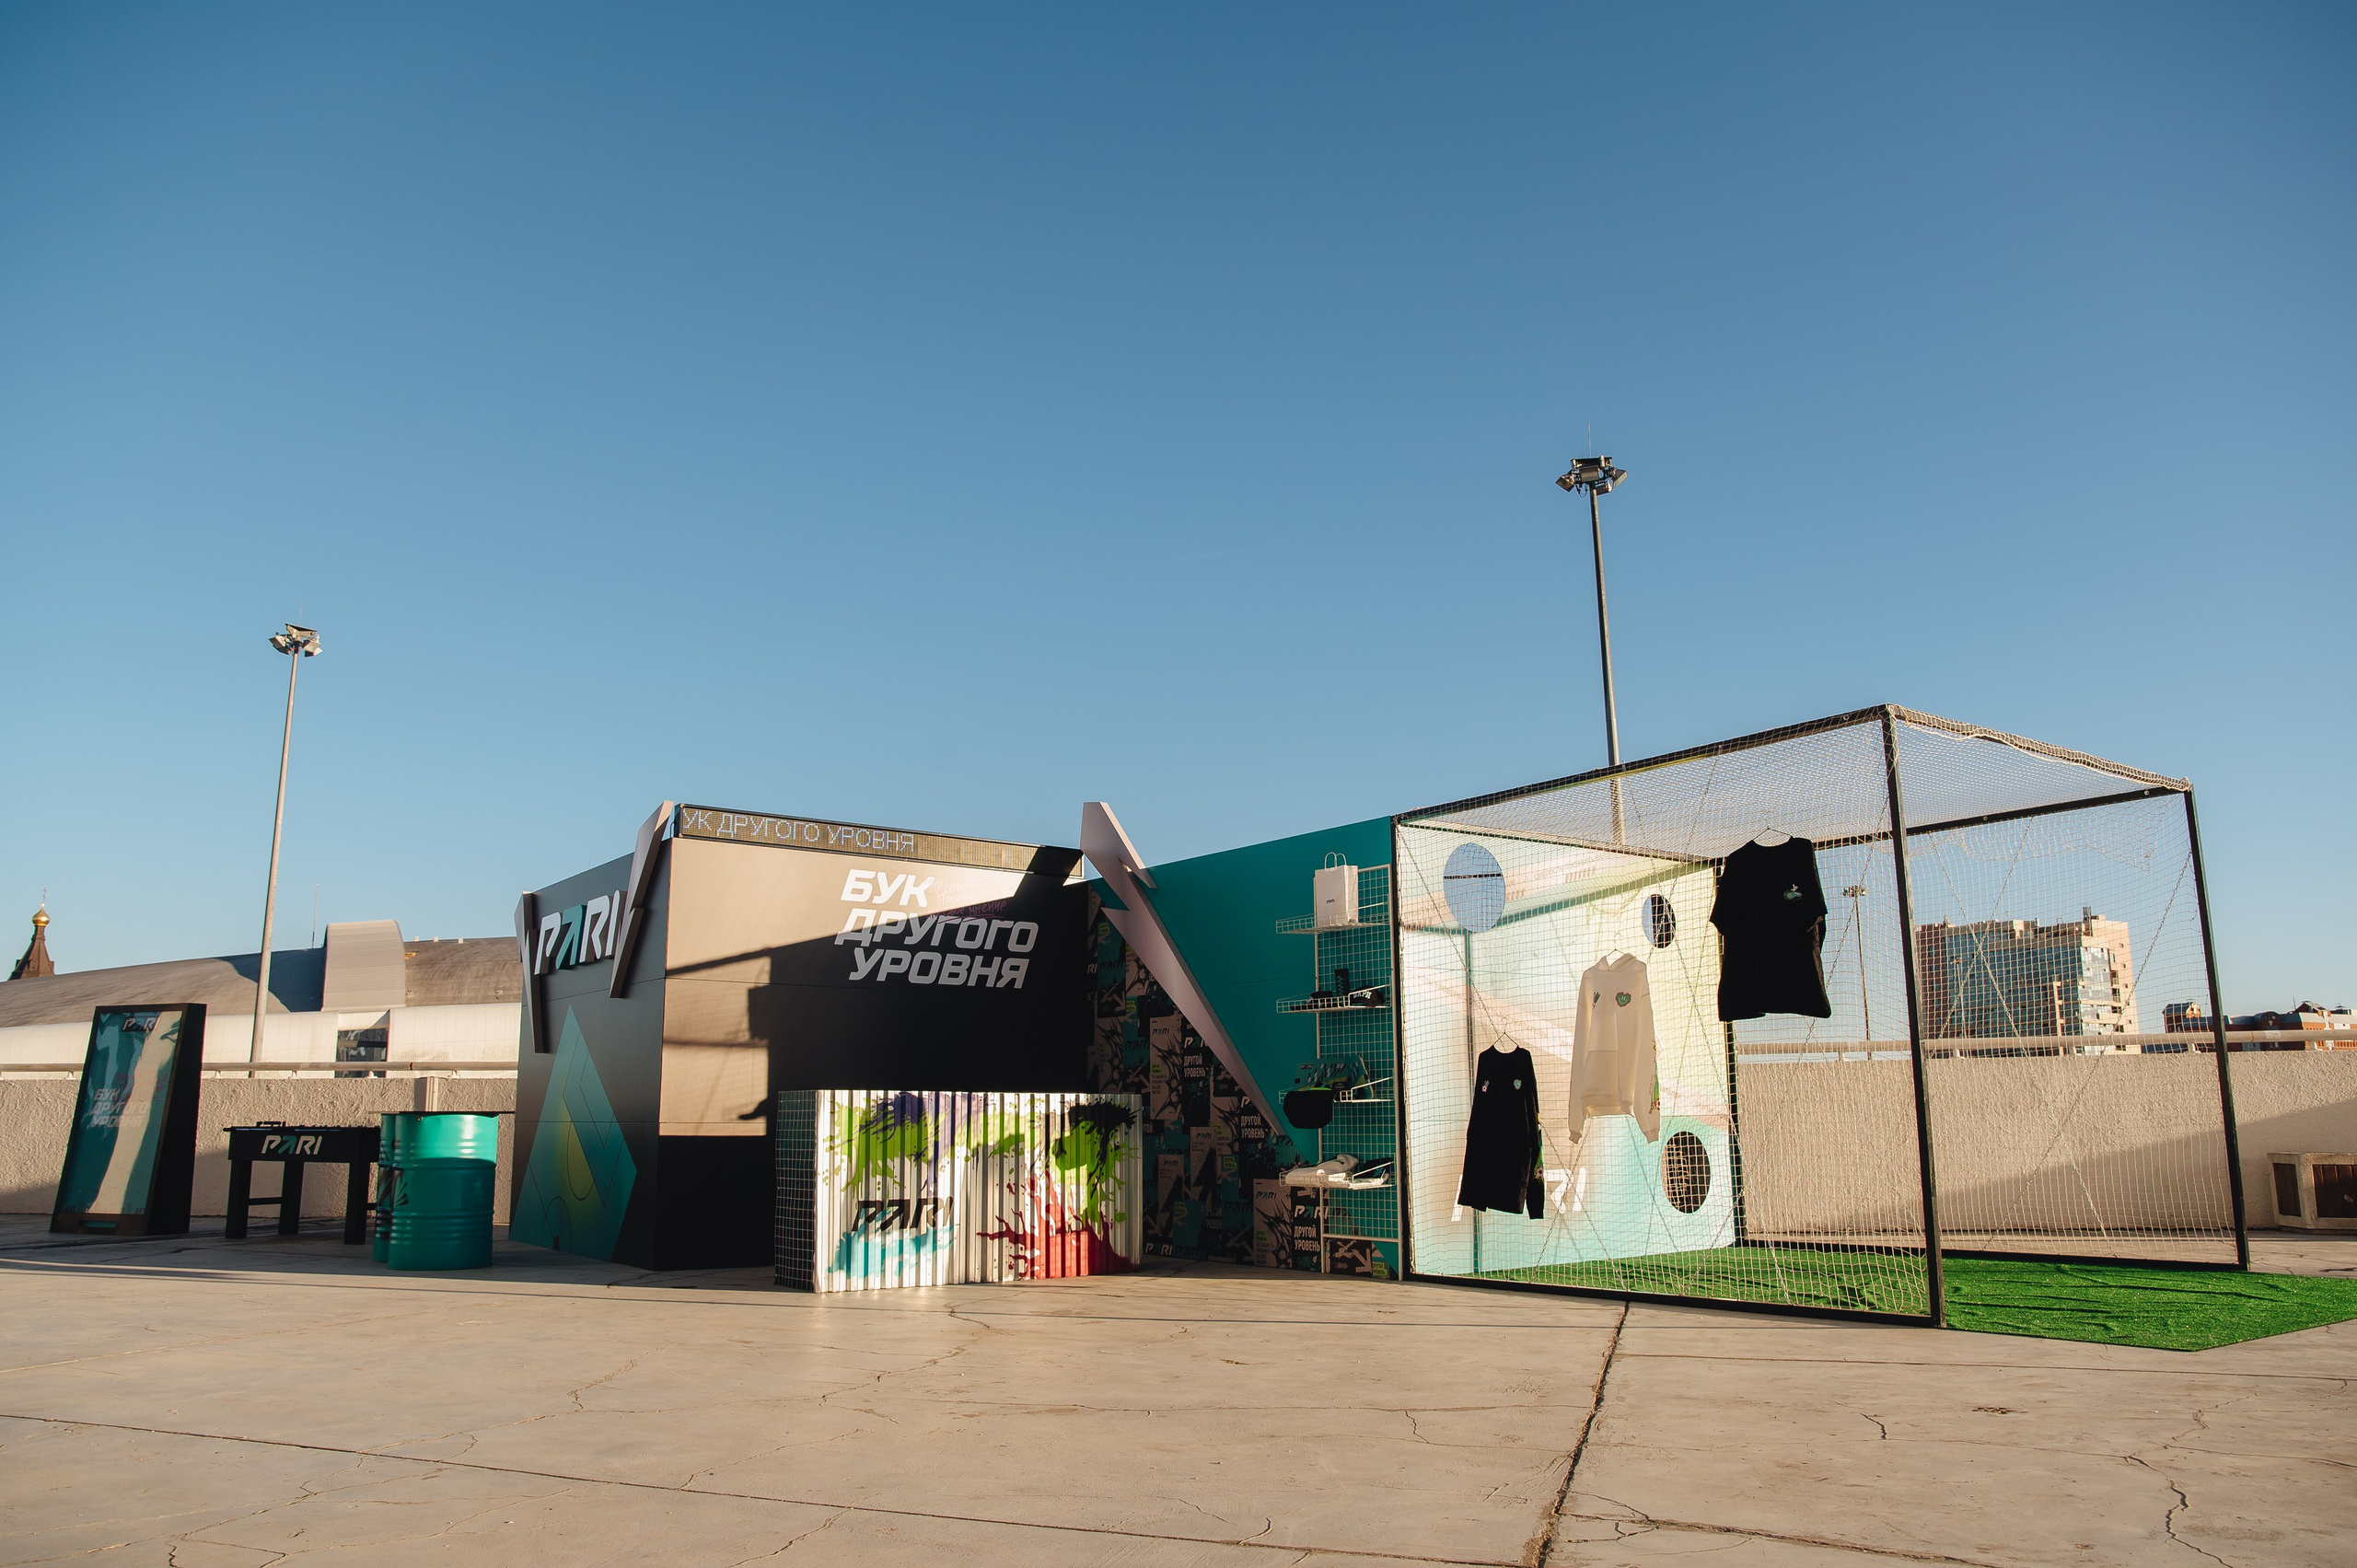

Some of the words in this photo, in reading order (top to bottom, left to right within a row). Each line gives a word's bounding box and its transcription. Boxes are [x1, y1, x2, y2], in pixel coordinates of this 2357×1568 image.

[716, 813, 820, 842] ДРУГОГО
[827, 825, 914, 853] УРОВНЯ
[840, 868, 935, 908] БУК
[534, 889, 621, 976] PARI
[834, 908, 1039, 953] ДРУГОГО
[849, 947, 1030, 989] УРОВНЯ
[1183, 1052, 1202, 1067] ДРУГОЙ
[94, 1088, 121, 1100] БУК
[89, 1101, 148, 1115] ДРУГОГО
[90, 1115, 145, 1127] УРОВНЯ
[1240, 1113, 1261, 1127] ДРУГОЙ
[261, 1135, 322, 1155] PARI
[1256, 1191, 1277, 1200] PARI
[851, 1196, 954, 1232] PARI
[1294, 1204, 1329, 1219] PARI
[1206, 1218, 1223, 1229] РОВЕН
[1294, 1225, 1317, 1238] ДРУГОЙ
[1294, 1239, 1320, 1252] УРОВЕНЬ
